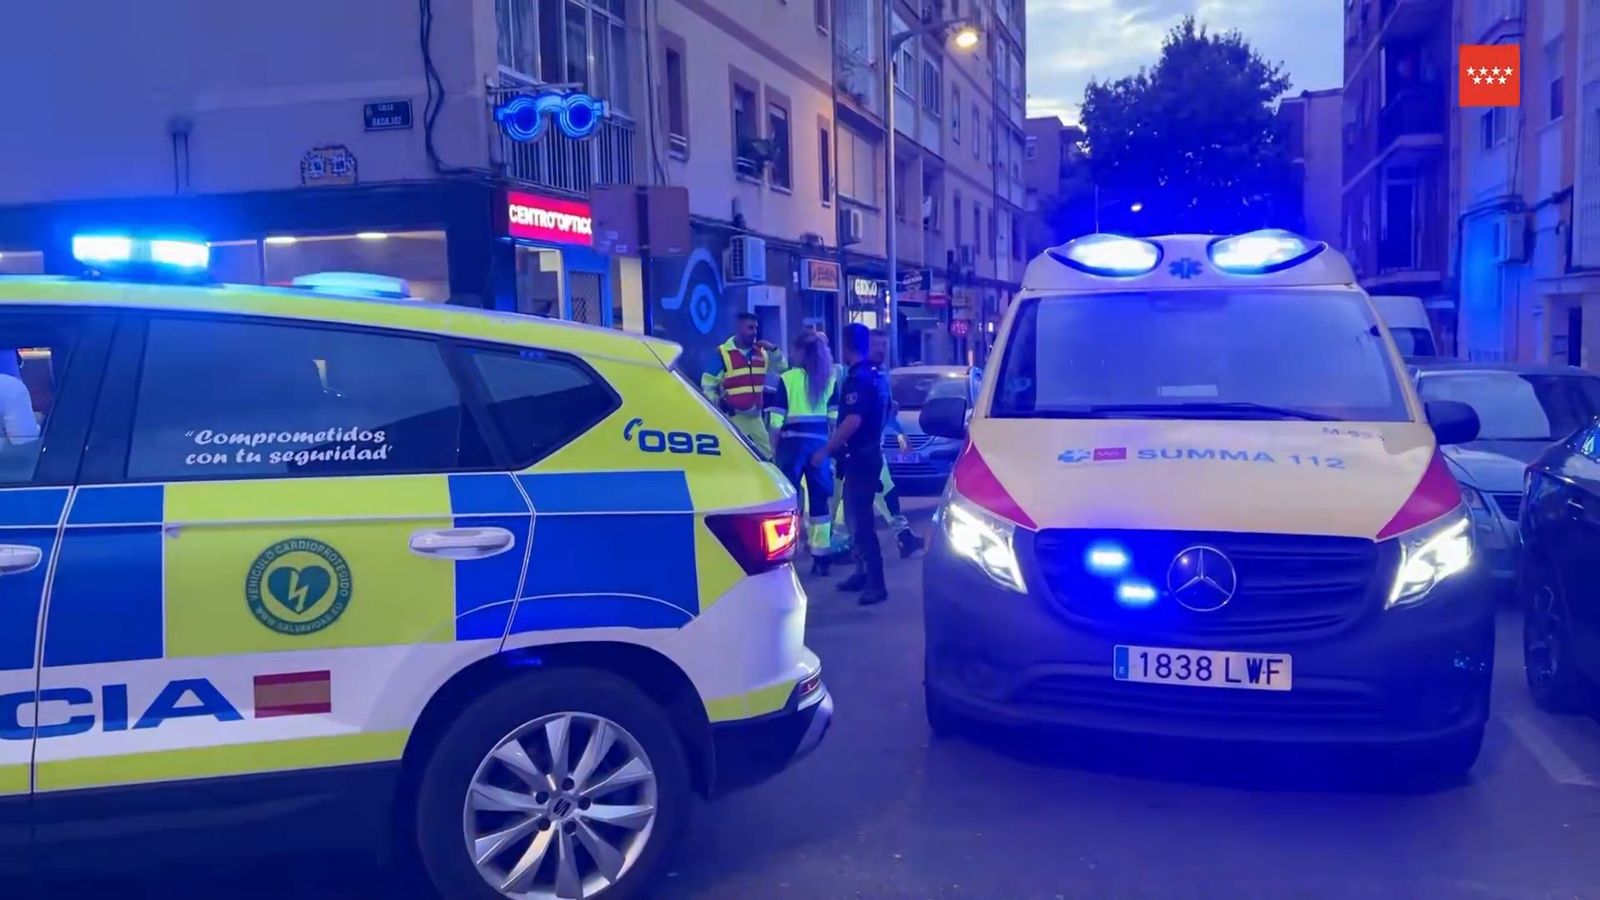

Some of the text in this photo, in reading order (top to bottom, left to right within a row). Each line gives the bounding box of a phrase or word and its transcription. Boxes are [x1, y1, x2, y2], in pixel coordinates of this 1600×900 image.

[638, 429, 721, 456] 092
[185, 453, 227, 465] con
[236, 448, 262, 463] tu
[1136, 448, 1346, 469] SUMMA 112
[1140, 652, 1284, 685] 1838 LWF
